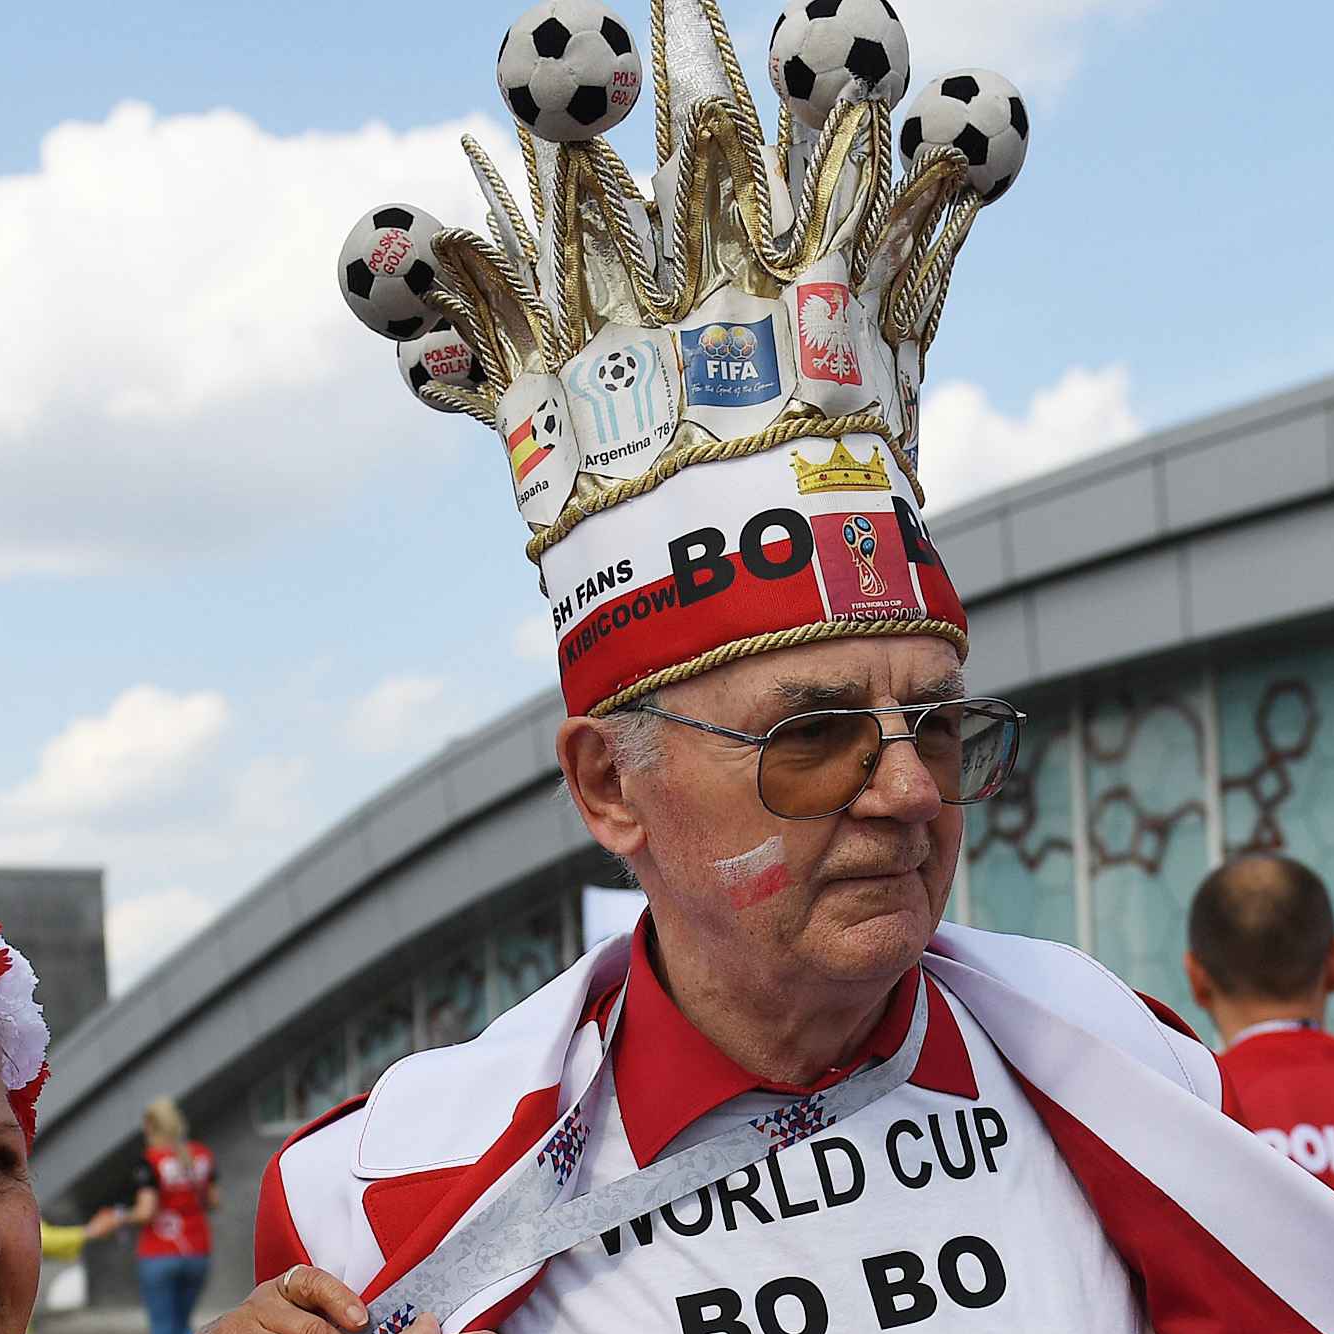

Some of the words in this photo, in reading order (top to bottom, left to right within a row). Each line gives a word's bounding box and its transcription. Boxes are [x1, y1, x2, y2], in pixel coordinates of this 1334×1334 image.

[369, 229, 404, 272] POLSKA
[424, 343, 469, 363] POLSKA
[706, 359, 760, 381] FIFA
[584, 436, 651, 470] Argentina
[654, 422, 671, 441] '78
[668, 506, 816, 608] BO
[575, 559, 634, 610] FANS
[851, 601, 867, 610] FIFA
[866, 600, 889, 609] WORLD
[890, 599, 903, 607] CUP
[885, 1107, 1008, 1190] CUP
[861, 1235, 1007, 1331] BO
